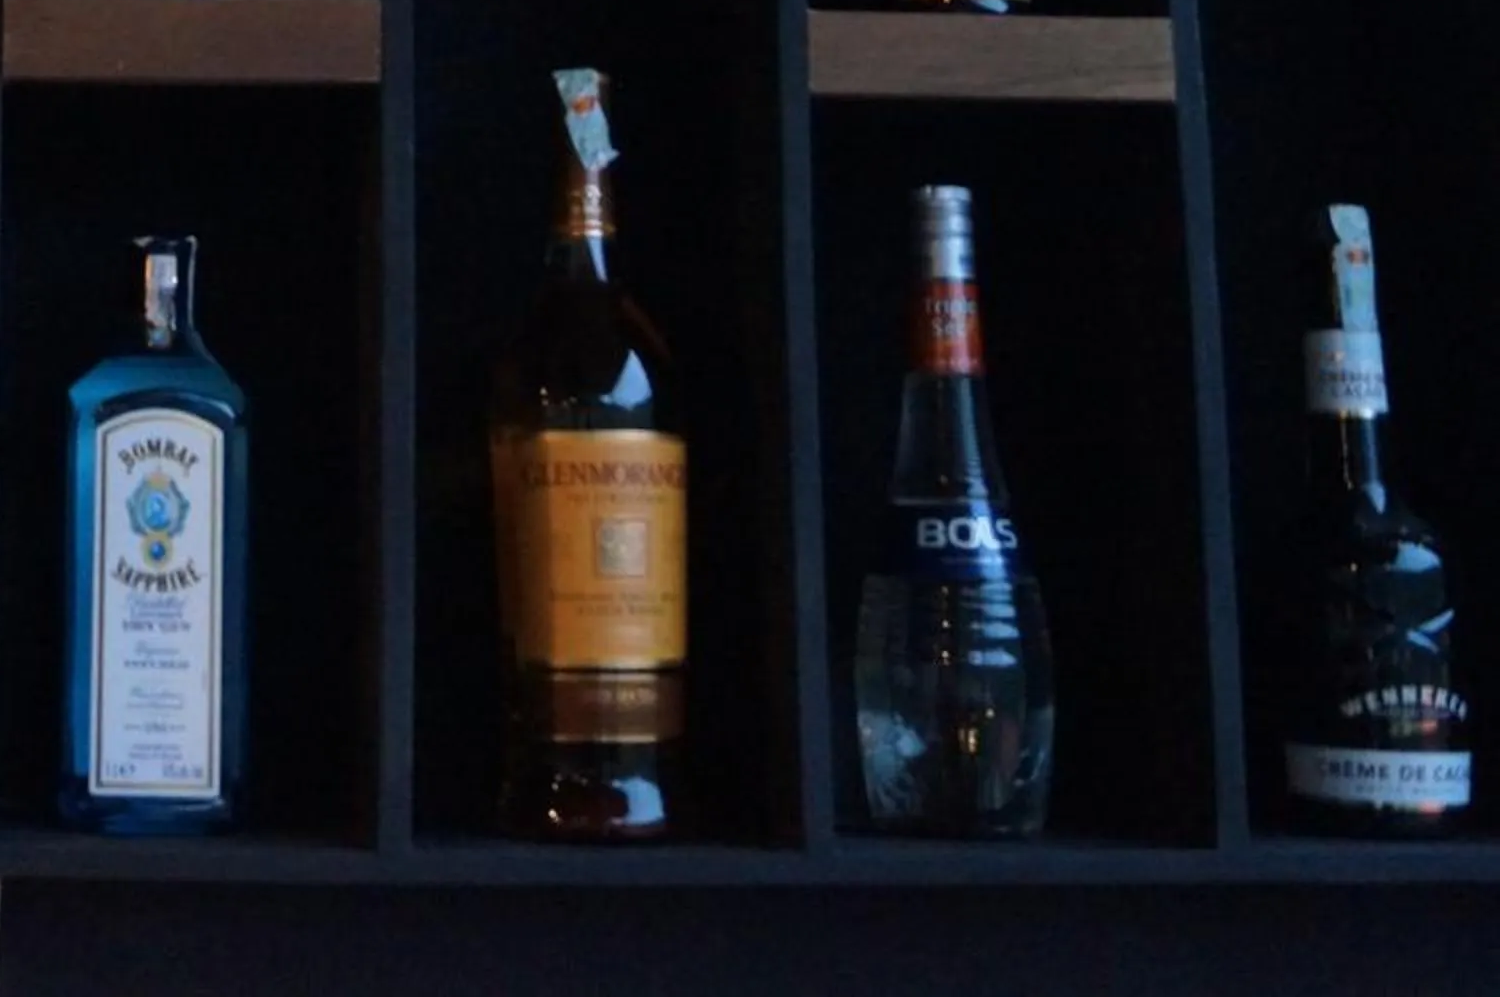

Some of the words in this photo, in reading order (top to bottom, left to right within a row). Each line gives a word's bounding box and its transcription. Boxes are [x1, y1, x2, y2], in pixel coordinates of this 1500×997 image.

[117, 438, 199, 478] BOMBAY
[916, 516, 1019, 550] BOLS
[111, 556, 206, 593] SAPPHIRE
[1399, 764, 1426, 782] DE
